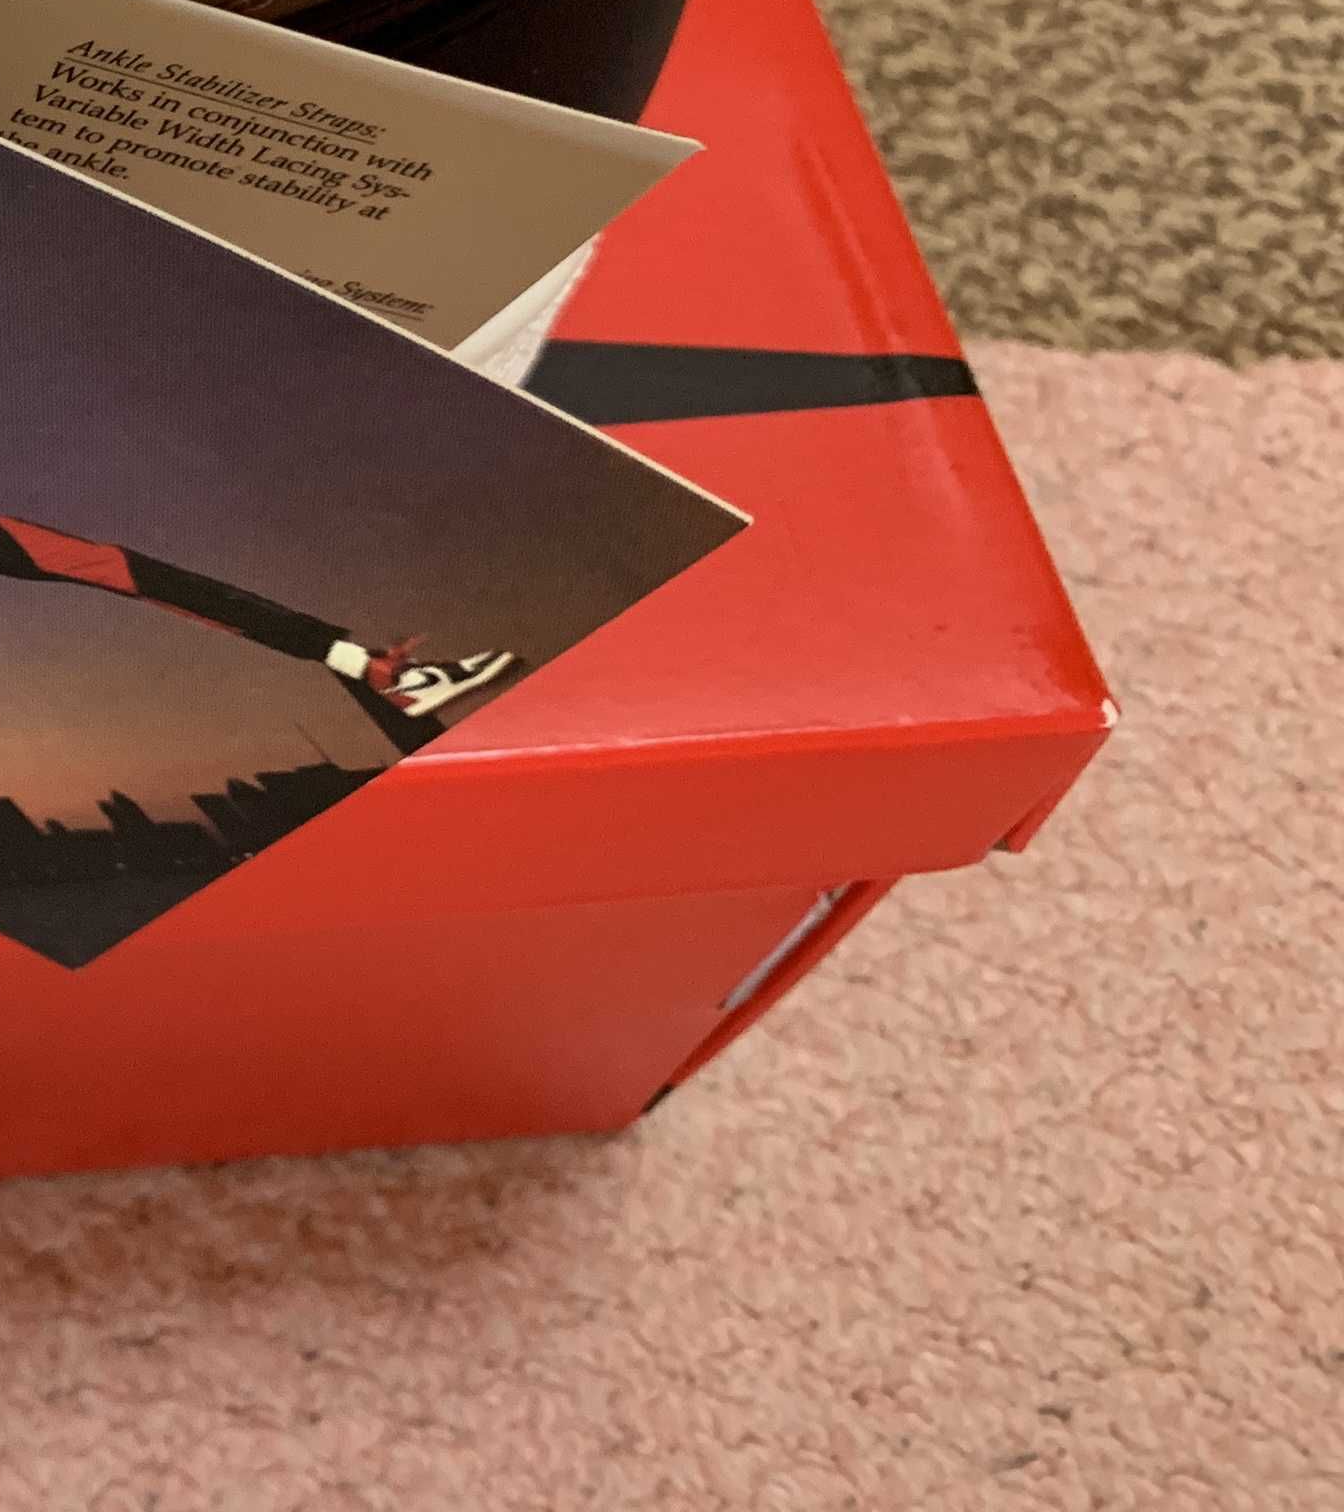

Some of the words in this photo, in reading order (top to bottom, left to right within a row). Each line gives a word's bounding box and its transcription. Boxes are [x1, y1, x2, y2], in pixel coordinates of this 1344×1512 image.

[34, 84, 150, 130] Variable
[157, 118, 246, 157] Width
[250, 145, 351, 187] Lacing
[351, 173, 411, 198] Sys-
[50, 61, 145, 102] Works
[148, 91, 182, 113] in
[187, 105, 360, 162] conjunction
[366, 153, 433, 181] with
[66, 40, 153, 73] Ankle
[156, 63, 289, 110] Stabilizer
[290, 101, 387, 139] Straps:
[10, 107, 67, 135] tem
[74, 125, 105, 144] to
[104, 138, 235, 180] promote
[237, 168, 356, 214] stability
[358, 204, 390, 221] at
[44, 147, 129, 180] ankle.
